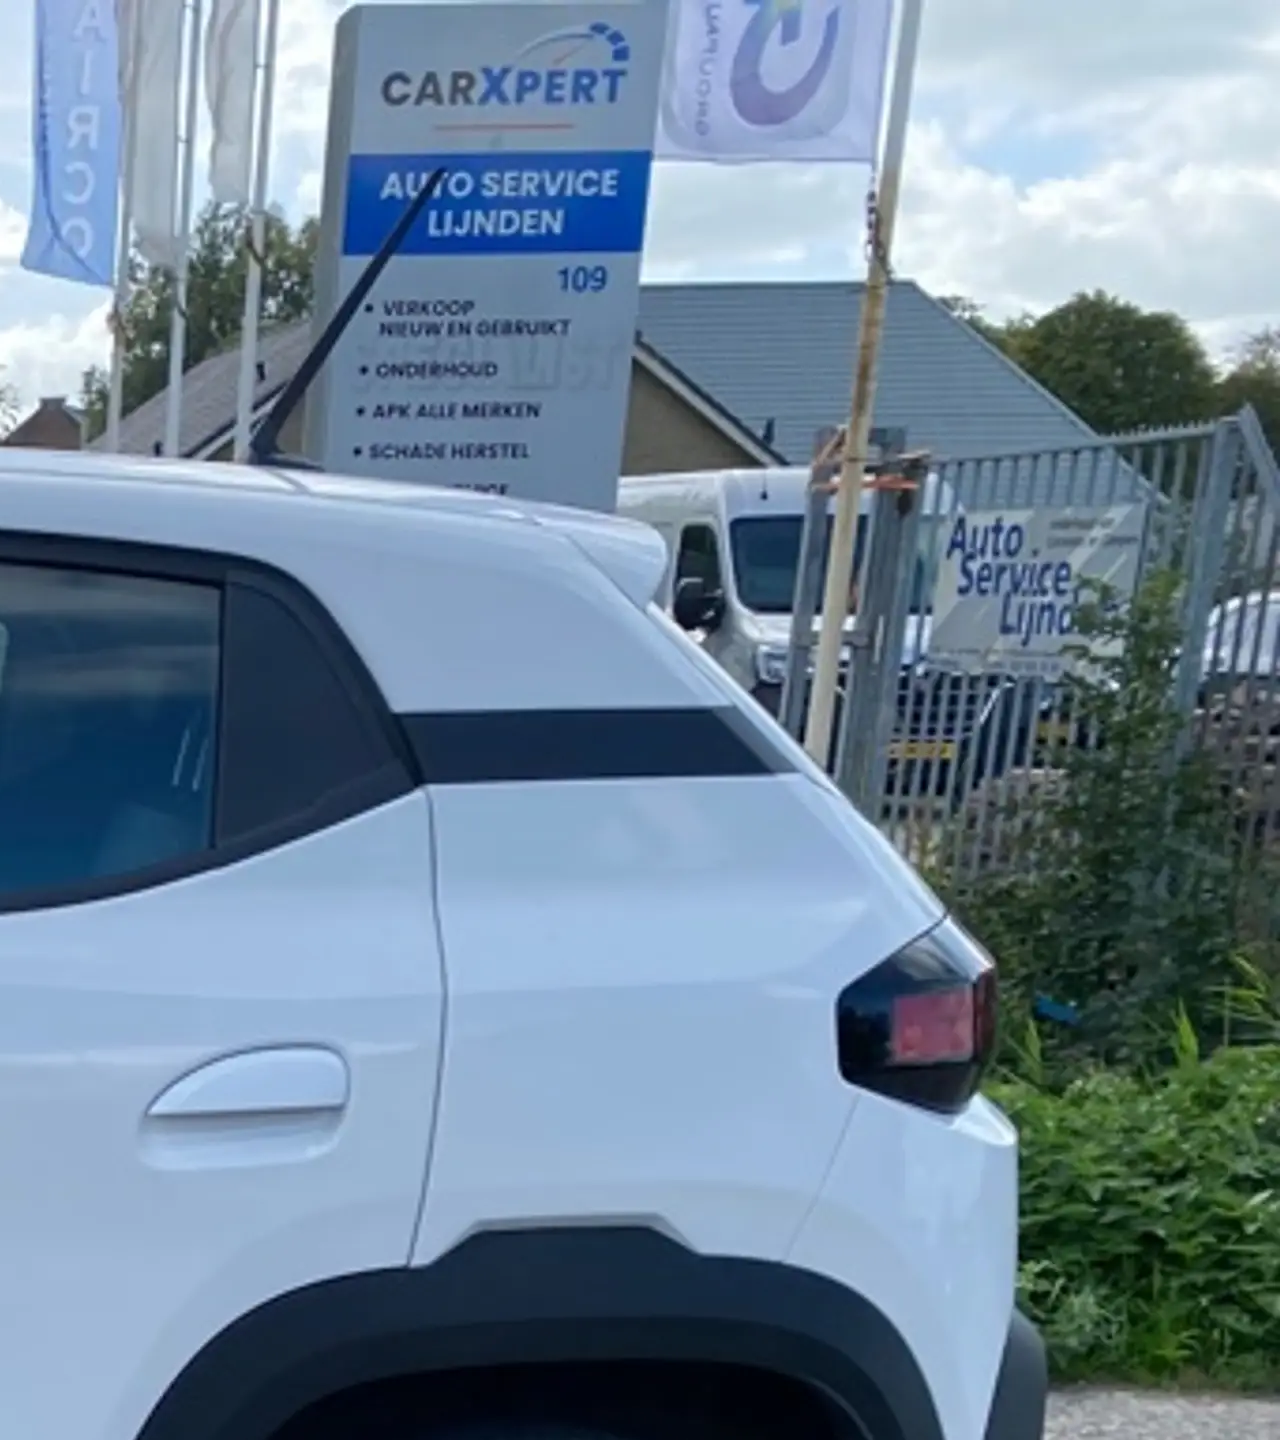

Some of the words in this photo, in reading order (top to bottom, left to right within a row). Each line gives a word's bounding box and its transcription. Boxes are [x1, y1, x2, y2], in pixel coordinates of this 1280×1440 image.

[381, 66, 628, 106] CARXPERT
[379, 170, 474, 200] AUTO
[481, 168, 620, 197] SERVICE
[427, 209, 565, 237] LIJNDEN
[557, 265, 608, 293] 109
[383, 300, 475, 316] VERKOOP
[378, 320, 444, 338] NIEUW
[446, 319, 473, 336] EN
[475, 318, 572, 336] GEBRUIKT
[374, 363, 498, 379] ONDERHOUD
[371, 403, 411, 419] APK
[415, 403, 459, 420] ALLE
[461, 403, 542, 419] MERKEN
[368, 444, 445, 460] SCHADE
[450, 442, 531, 459] HERSTEL
[946, 516, 1024, 560] Auto
[956, 549, 1072, 598] Service
[999, 591, 1114, 648] Lijnd
